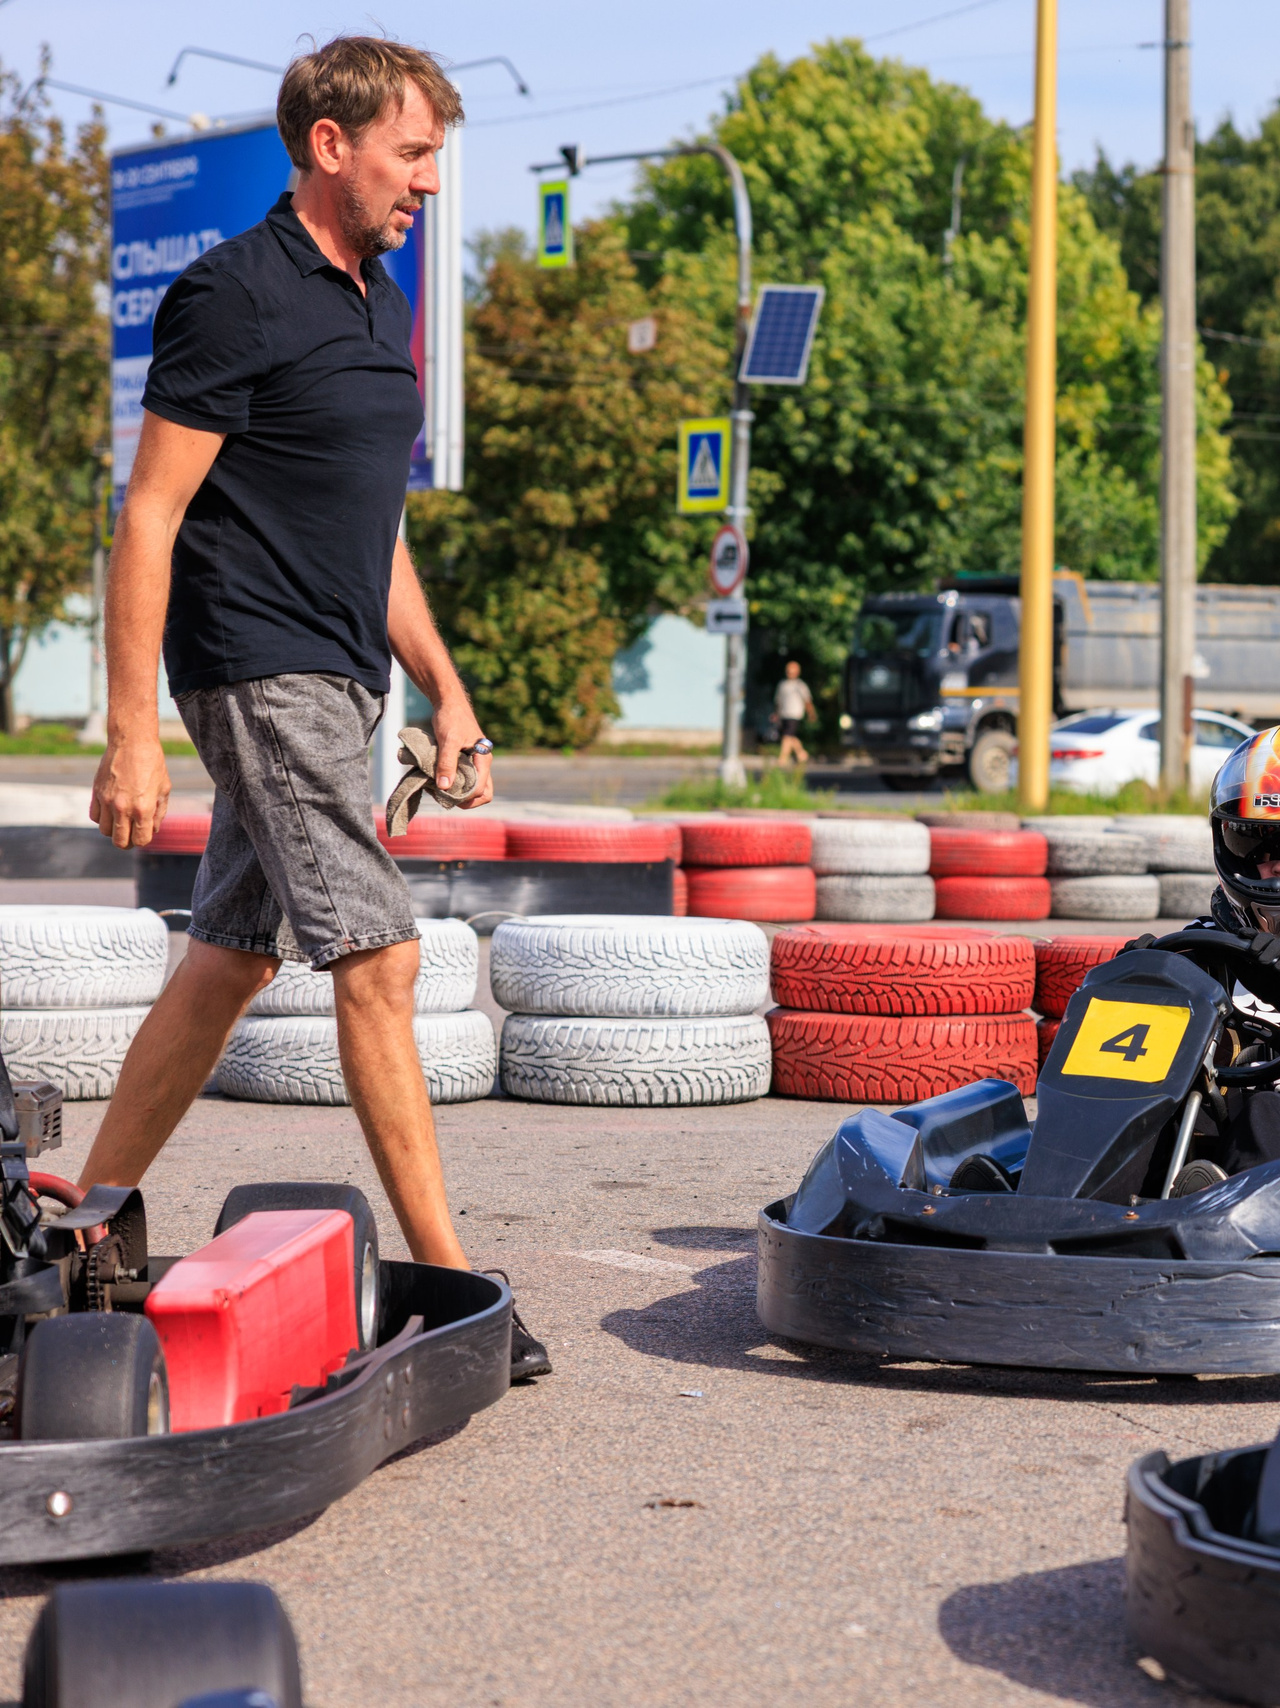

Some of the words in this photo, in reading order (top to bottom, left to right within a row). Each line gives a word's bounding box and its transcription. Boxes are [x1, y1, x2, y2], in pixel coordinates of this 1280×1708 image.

[111, 228, 228, 279] СЛЫШАТ
[112, 284, 169, 328] СЕР
[1099, 1023, 1151, 1062] 4
